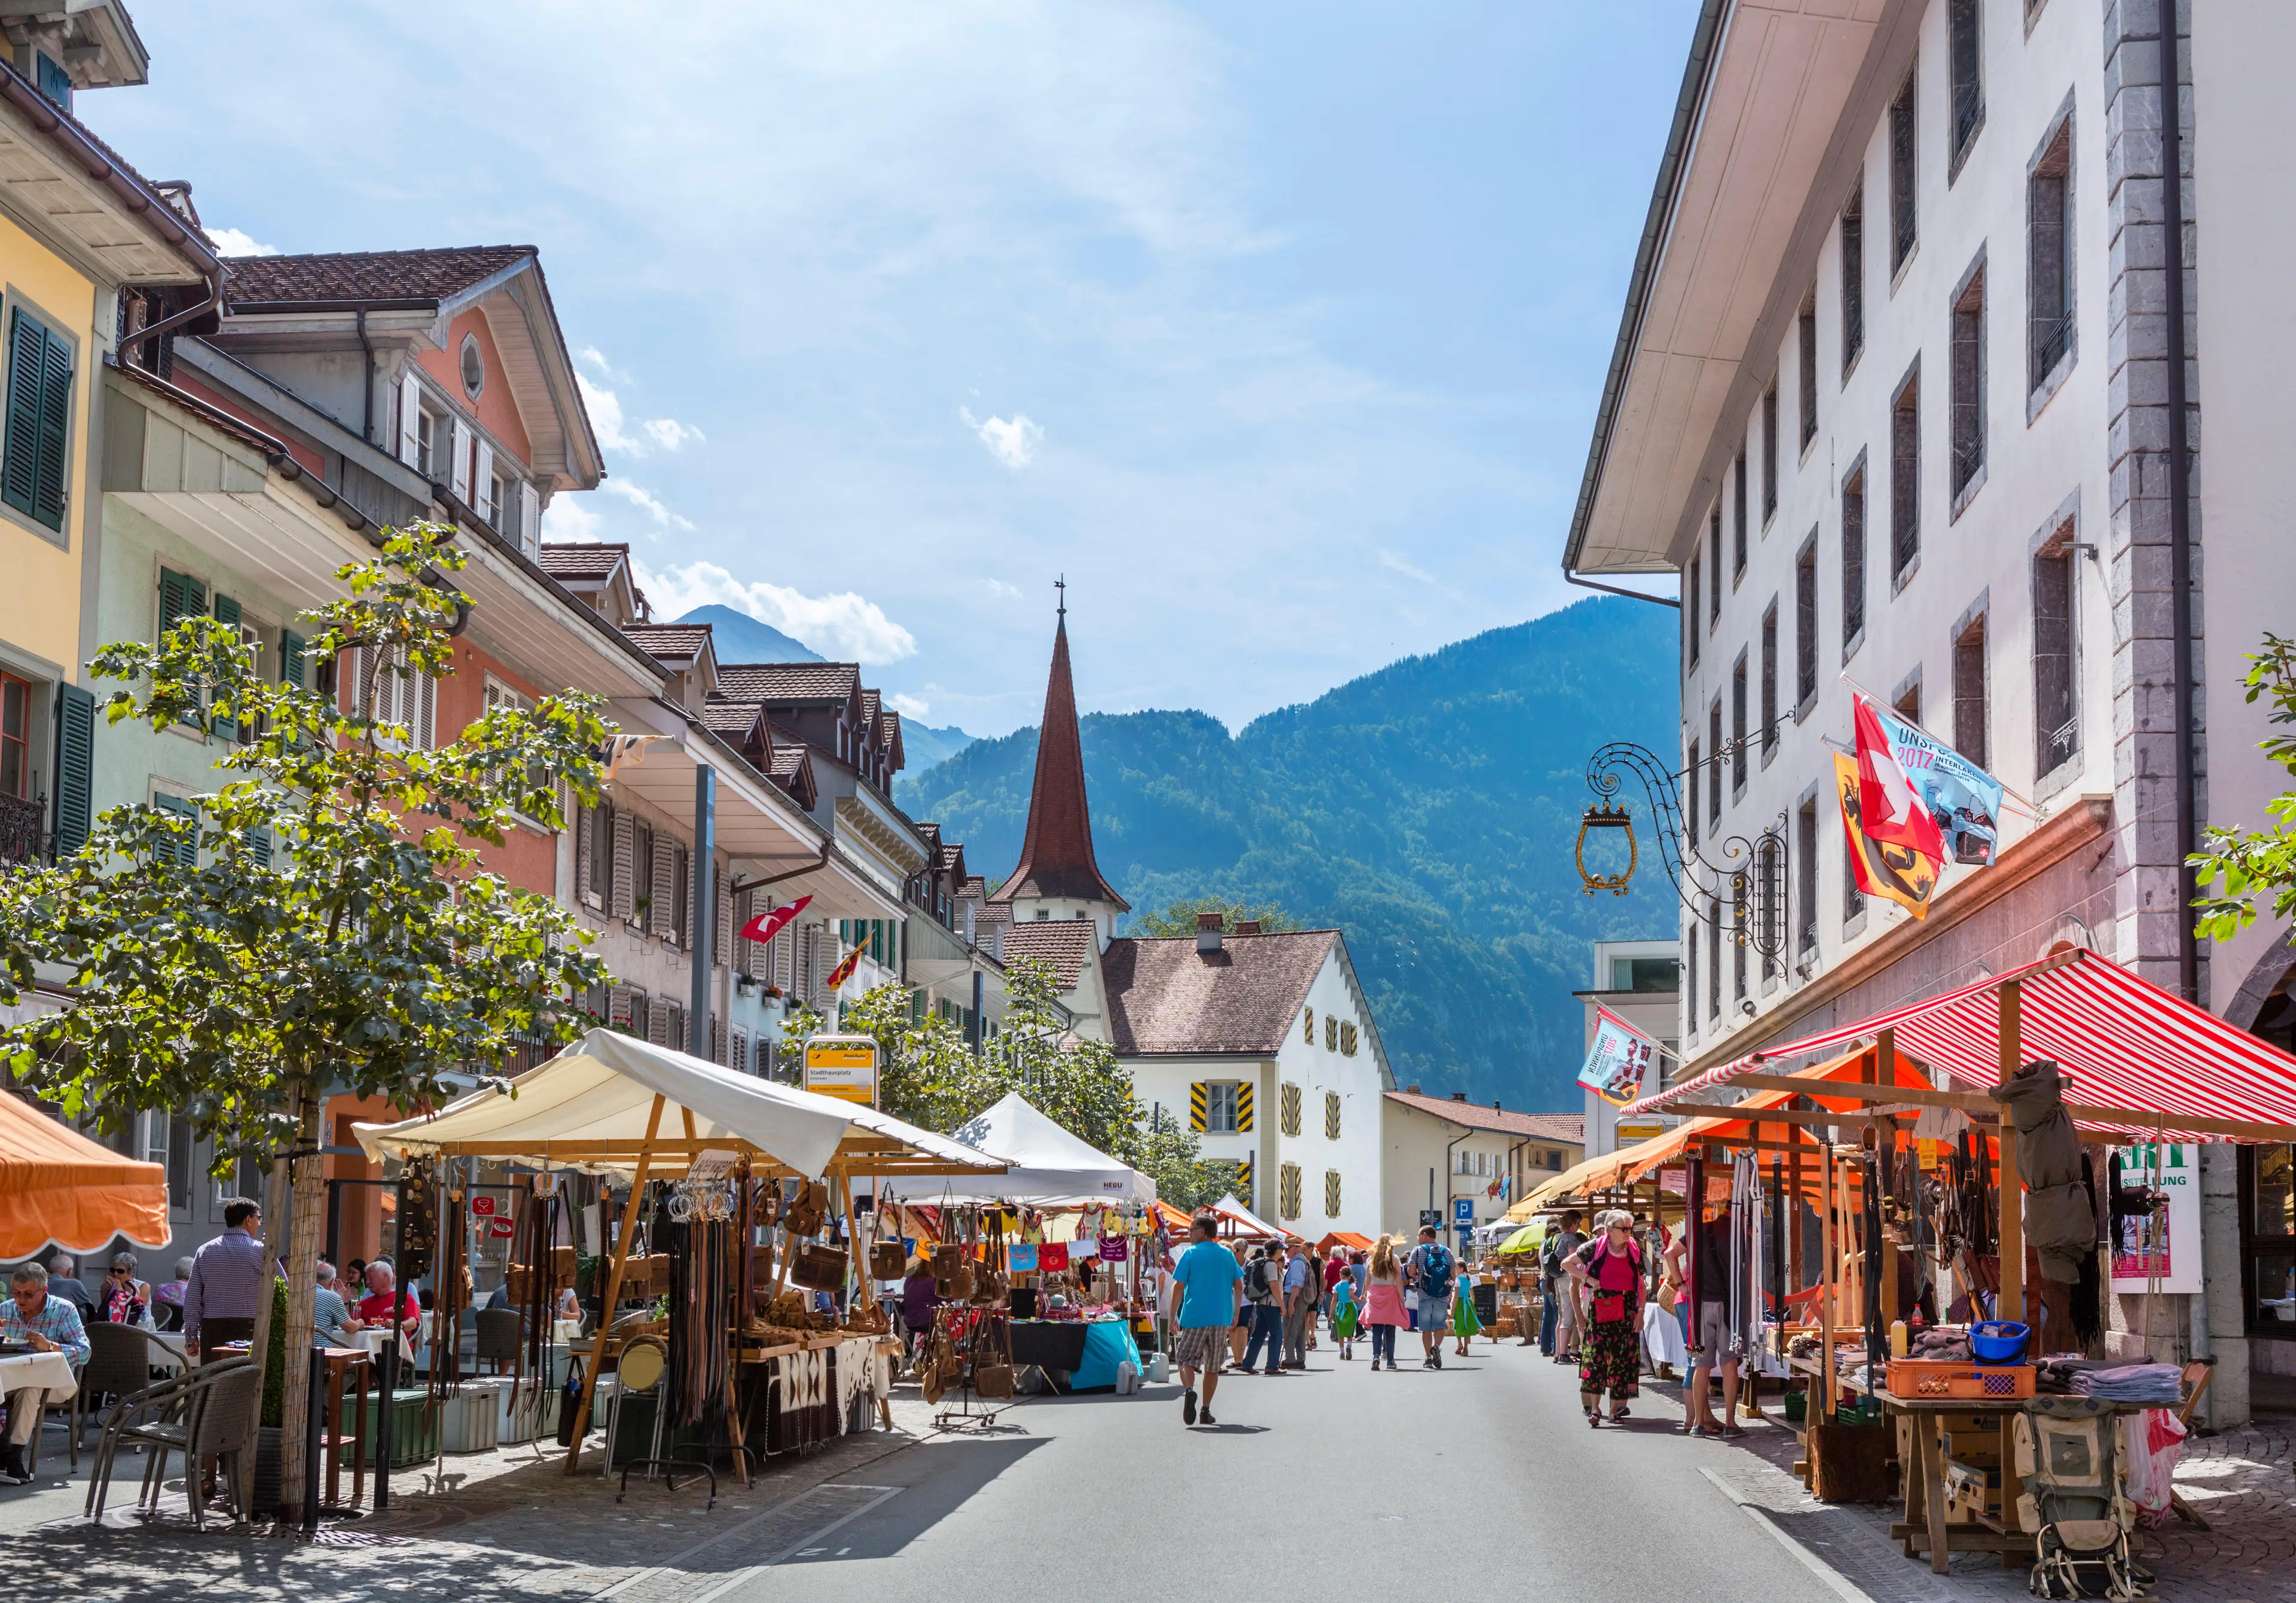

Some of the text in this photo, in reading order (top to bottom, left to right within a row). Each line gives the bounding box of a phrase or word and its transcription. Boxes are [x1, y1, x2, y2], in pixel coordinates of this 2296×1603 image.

[1898, 746, 1934, 770] 2017
[1935, 755, 1981, 780] INTERLAK
[1460, 1203, 1468, 1216] P
